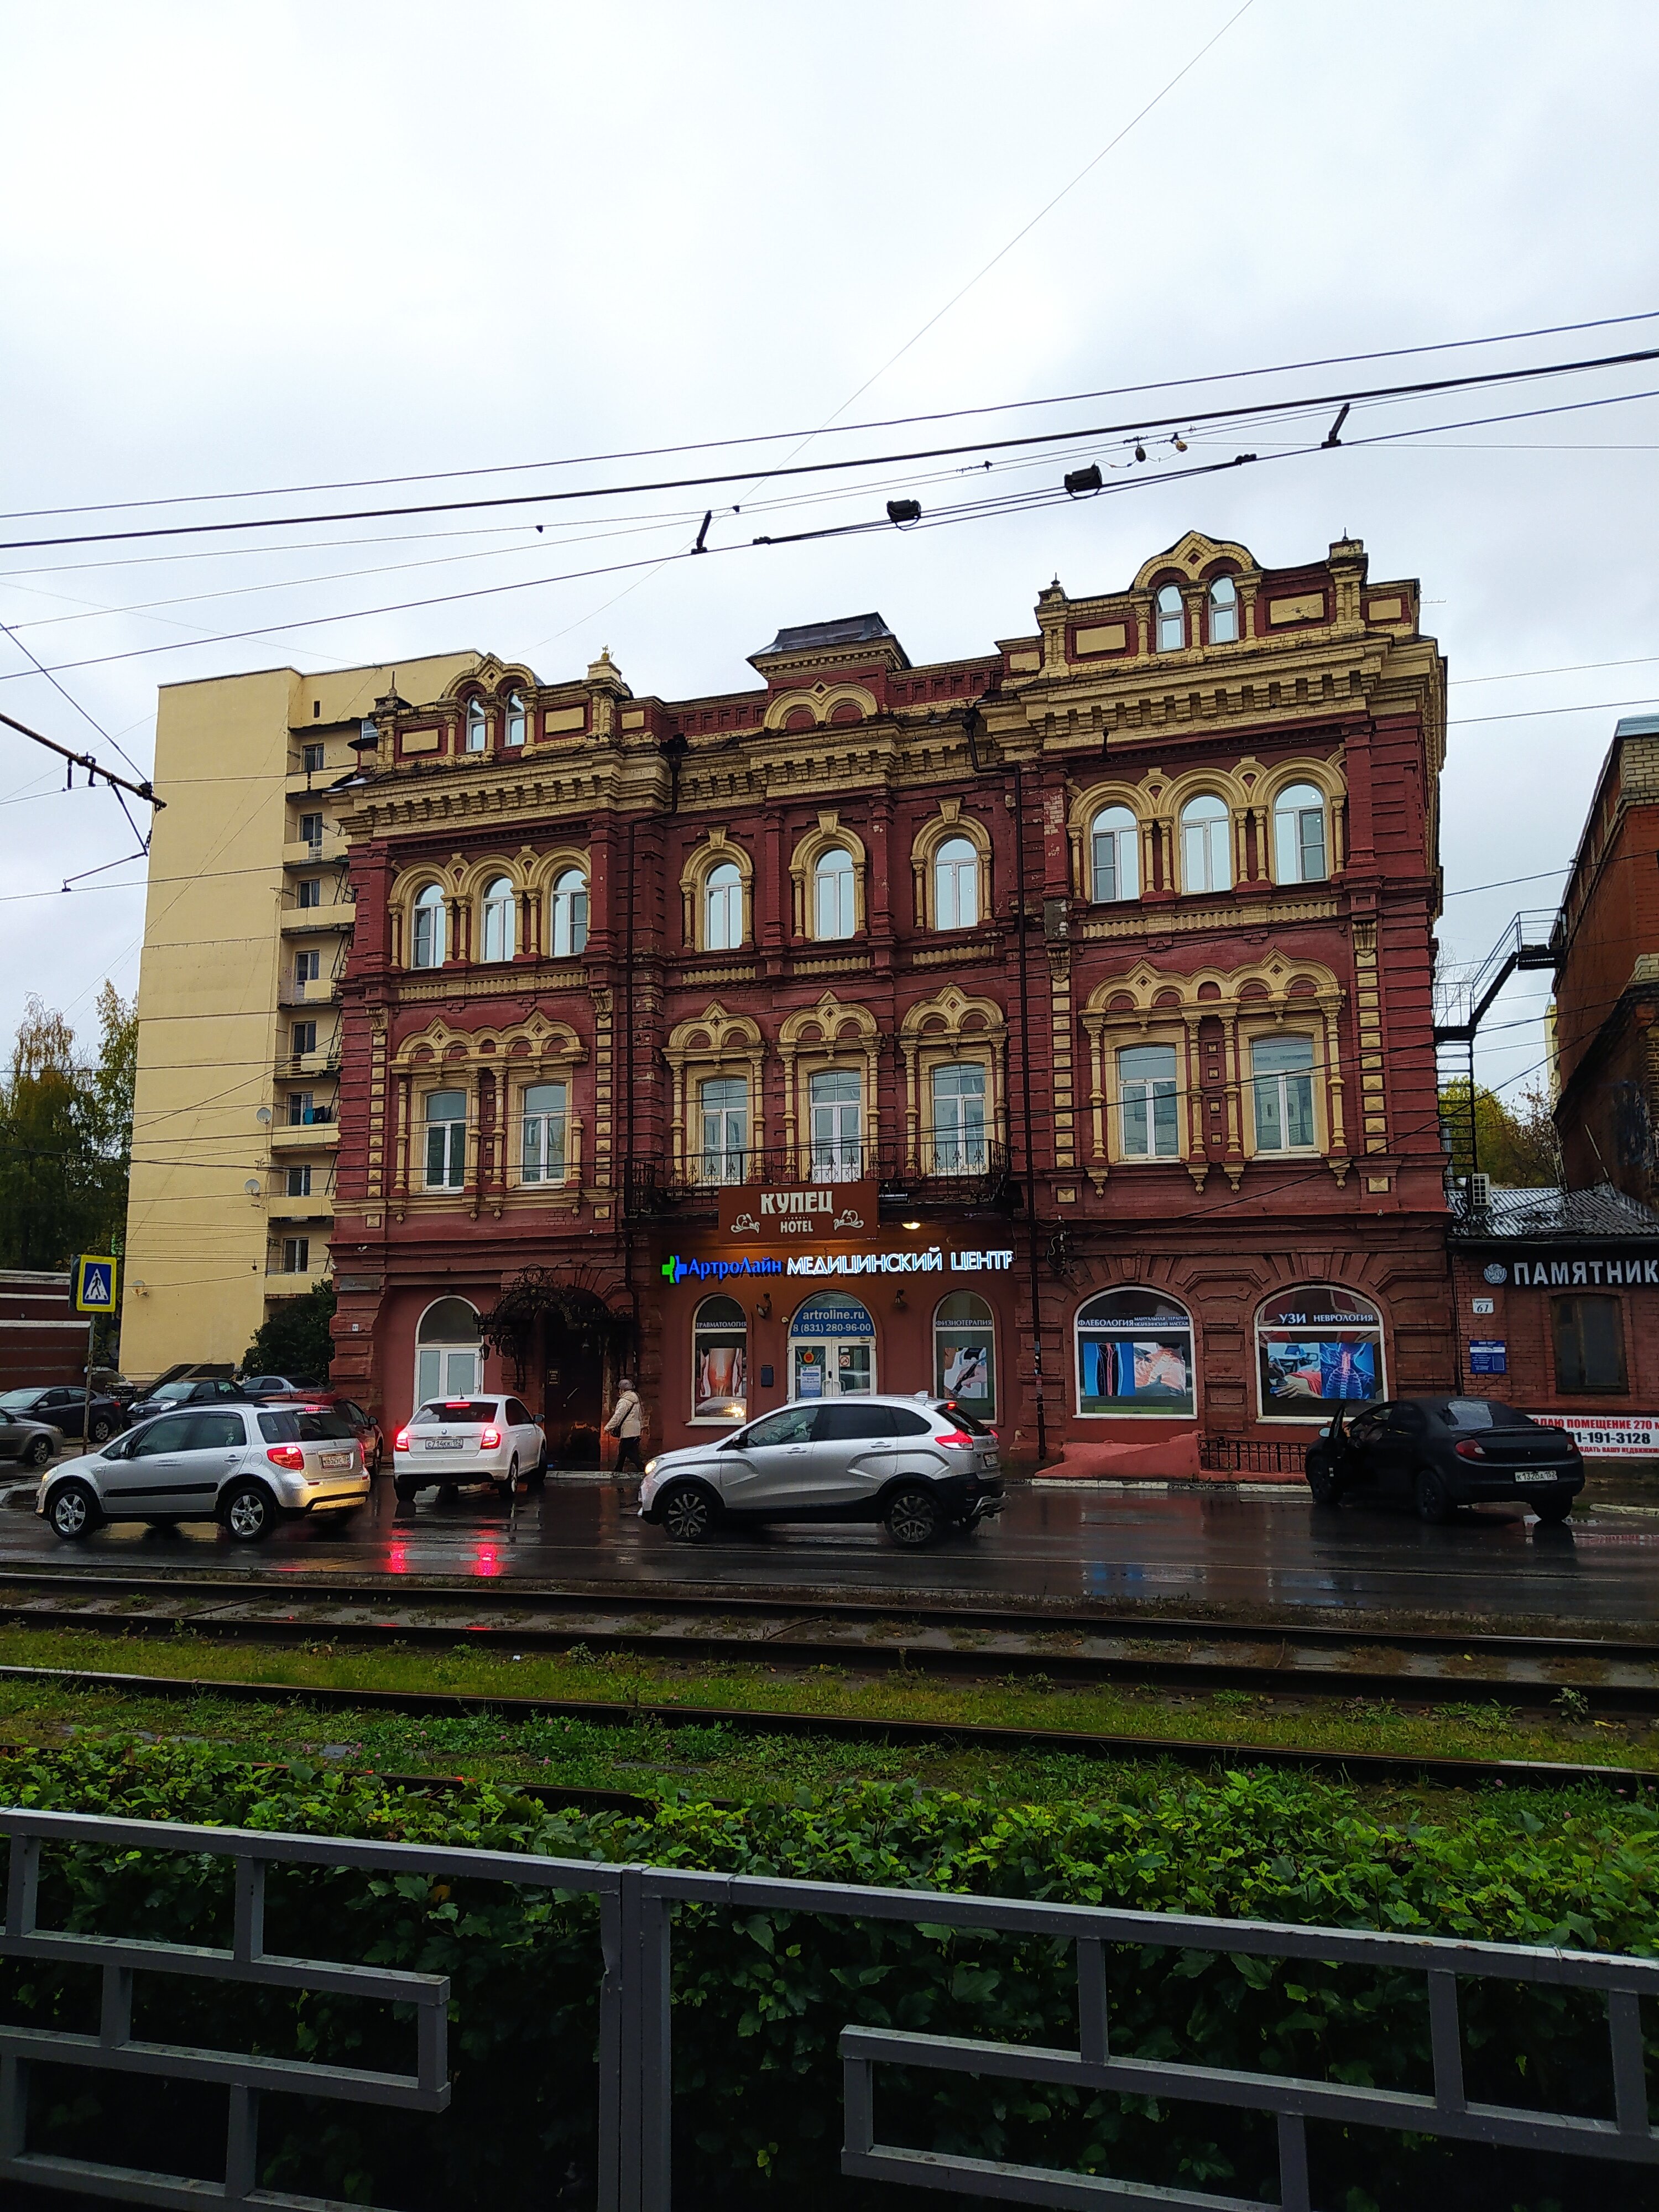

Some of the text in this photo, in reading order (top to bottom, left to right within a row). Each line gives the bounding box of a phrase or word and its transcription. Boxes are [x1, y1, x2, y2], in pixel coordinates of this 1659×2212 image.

[760, 1191, 833, 1214] КУПЕЦ
[780, 1219, 813, 1233] HOTEL
[688, 1247, 1013, 1280] АртроЛайн МЕДИЦИНСКИЙ ЦЕНТР
[1477, 1304, 1489, 1312] 61
[802, 1309, 864, 1320] artroline.ru
[1279, 1313, 1374, 1324] УЗИ НЕВРОЛОГИЯ
[793, 1323, 871, 1333] 8 (831) 280-96-00
[1567, 1419, 1631, 1431] ПОМЕЩЕНИЕ
[1633, 1420, 1652, 1430] 270
